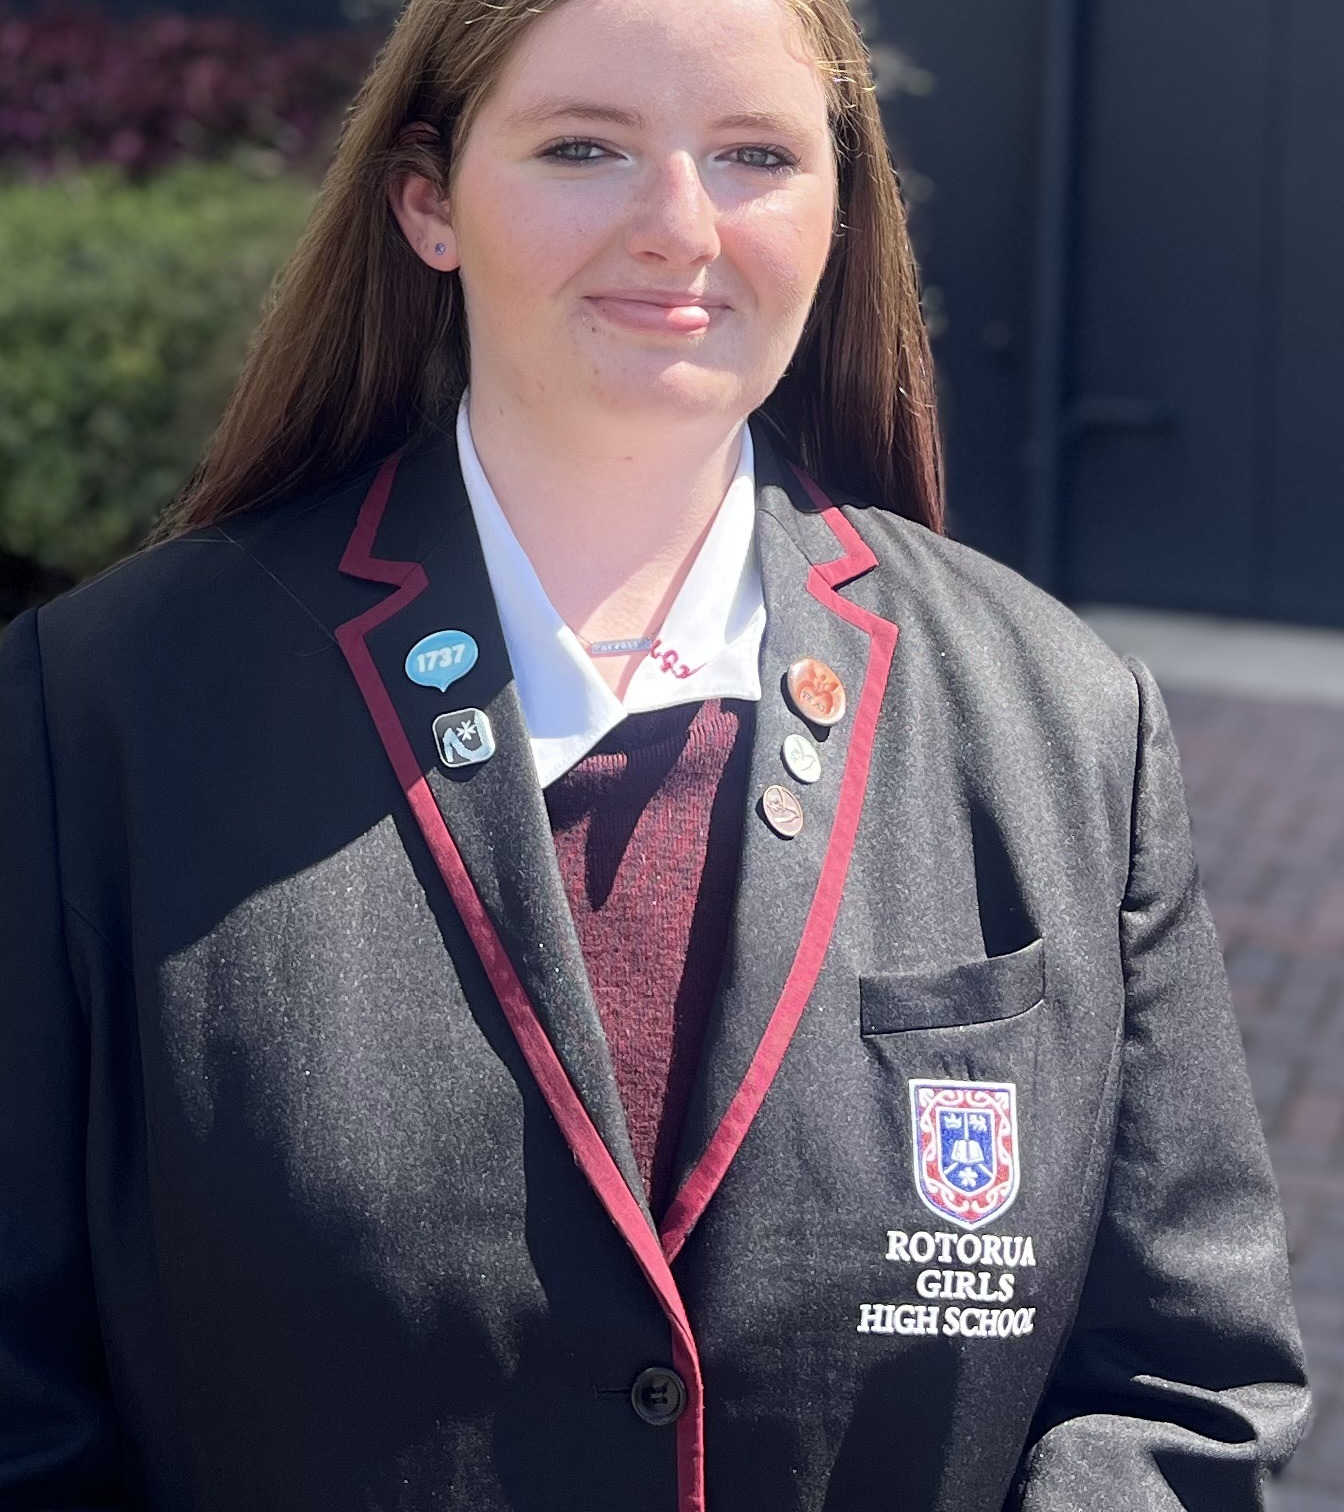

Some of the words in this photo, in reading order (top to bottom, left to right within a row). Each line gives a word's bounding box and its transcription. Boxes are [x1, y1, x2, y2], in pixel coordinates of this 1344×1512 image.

[417, 644, 465, 672] 1737
[885, 1230, 1037, 1266] ROTORUA
[916, 1269, 1015, 1302] GIRLS
[857, 1304, 940, 1335] HIGH
[942, 1306, 1036, 1337] SCHOOL
